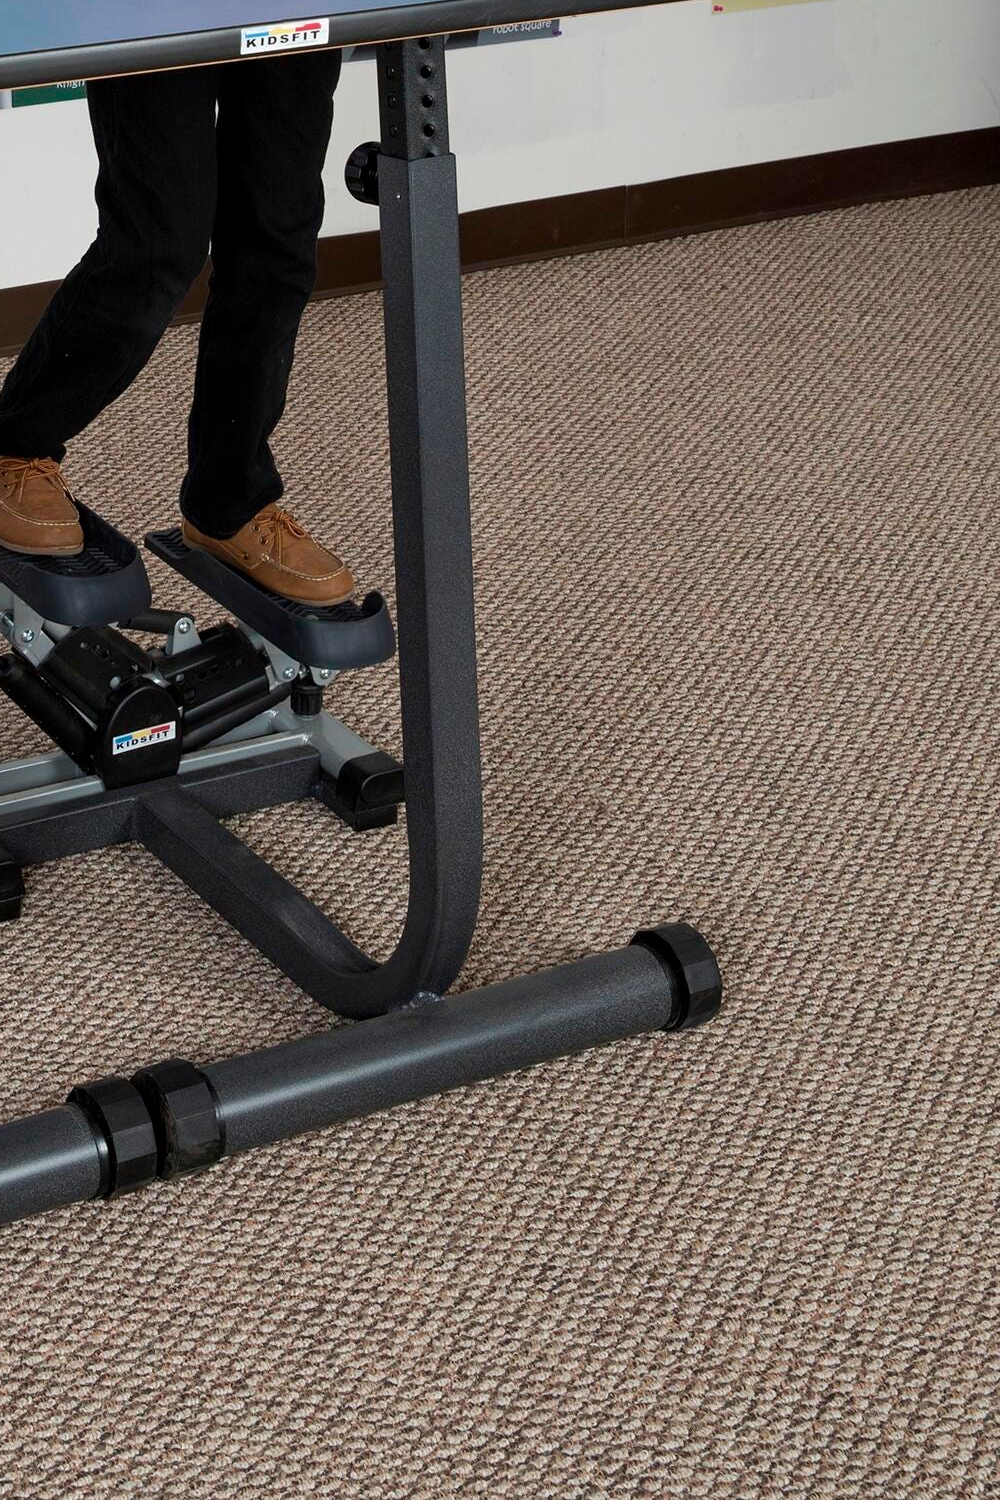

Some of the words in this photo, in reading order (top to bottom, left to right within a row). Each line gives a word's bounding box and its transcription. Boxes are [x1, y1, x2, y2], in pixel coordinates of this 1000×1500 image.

[493, 23, 518, 34] robot
[521, 20, 552, 32] square
[247, 30, 321, 48] KIDSFIT
[116, 729, 172, 751] KIDSFIT
